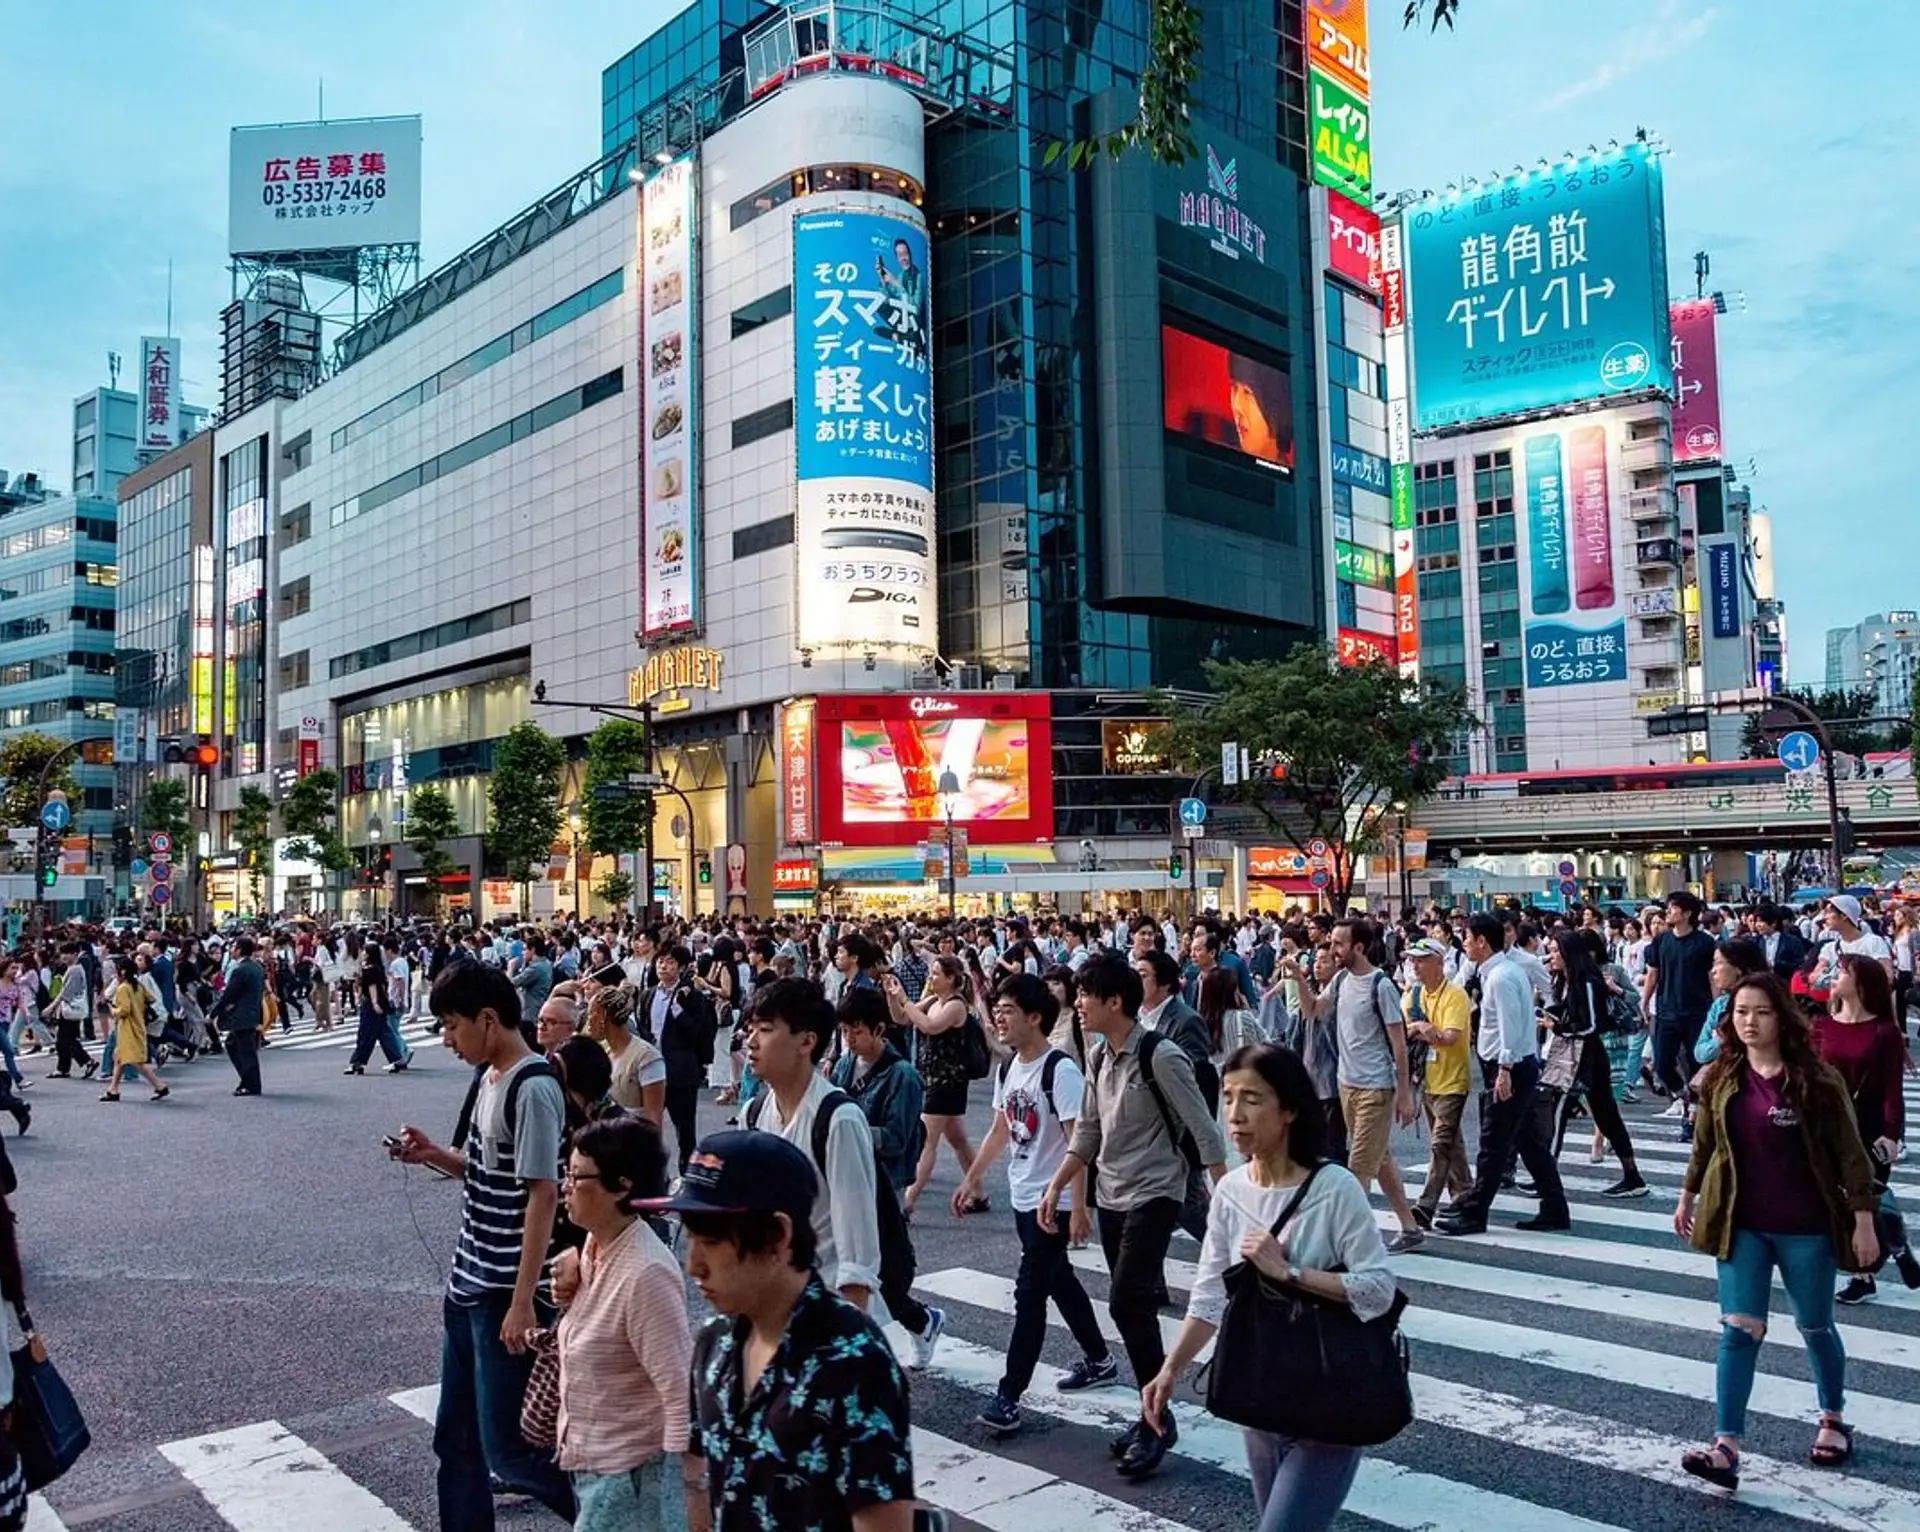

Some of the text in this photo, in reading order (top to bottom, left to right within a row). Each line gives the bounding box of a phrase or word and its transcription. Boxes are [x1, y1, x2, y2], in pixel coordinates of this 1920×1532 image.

[1315, 84, 1367, 142] レイク
[264, 152, 387, 182] 広告募集
[1316, 125, 1371, 183] ALSA
[263, 178, 387, 206] 03-5337-2468
[275, 201, 375, 220] 株式会社タップ
[1180, 191, 1266, 264] MAGNET
[1330, 214, 1380, 262] アイフル
[1460, 208, 1589, 290] 龍角散
[813, 262, 858, 284] その
[1446, 273, 1616, 348] ダイレクト
[1604, 353, 1645, 379] 生薬
[814, 365, 927, 424] 軽くして
[848, 588, 917, 604] DIGA
[1399, 594, 1414, 633] アコム
[1530, 634, 1624, 660] のど、直接、
[629, 647, 722, 706] MAGNET
[1540, 659, 1610, 682] うるおう
[911, 697, 960, 718] Glico
[1708, 792, 1735, 809] JR
